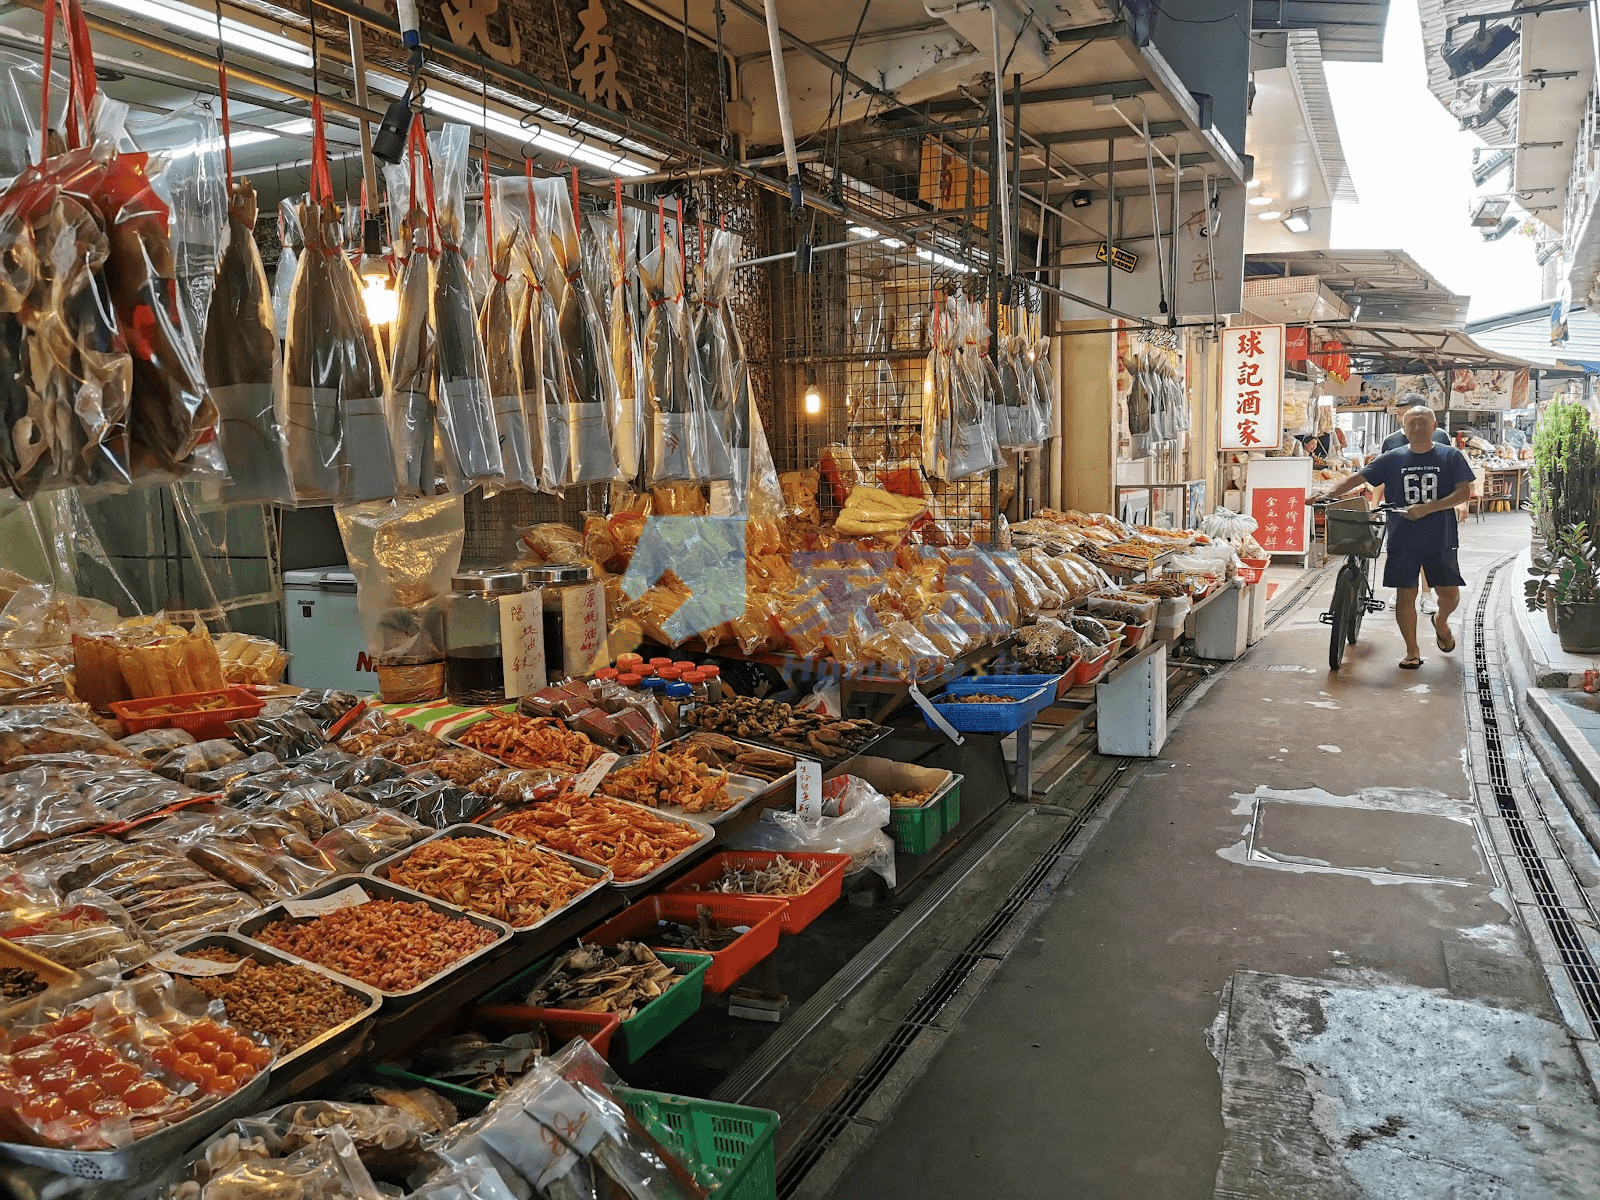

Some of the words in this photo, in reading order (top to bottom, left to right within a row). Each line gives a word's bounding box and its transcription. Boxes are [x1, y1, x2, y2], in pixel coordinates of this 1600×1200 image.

[1236, 330, 1265, 447] 球記酒家
[1403, 473, 1438, 504] 68
